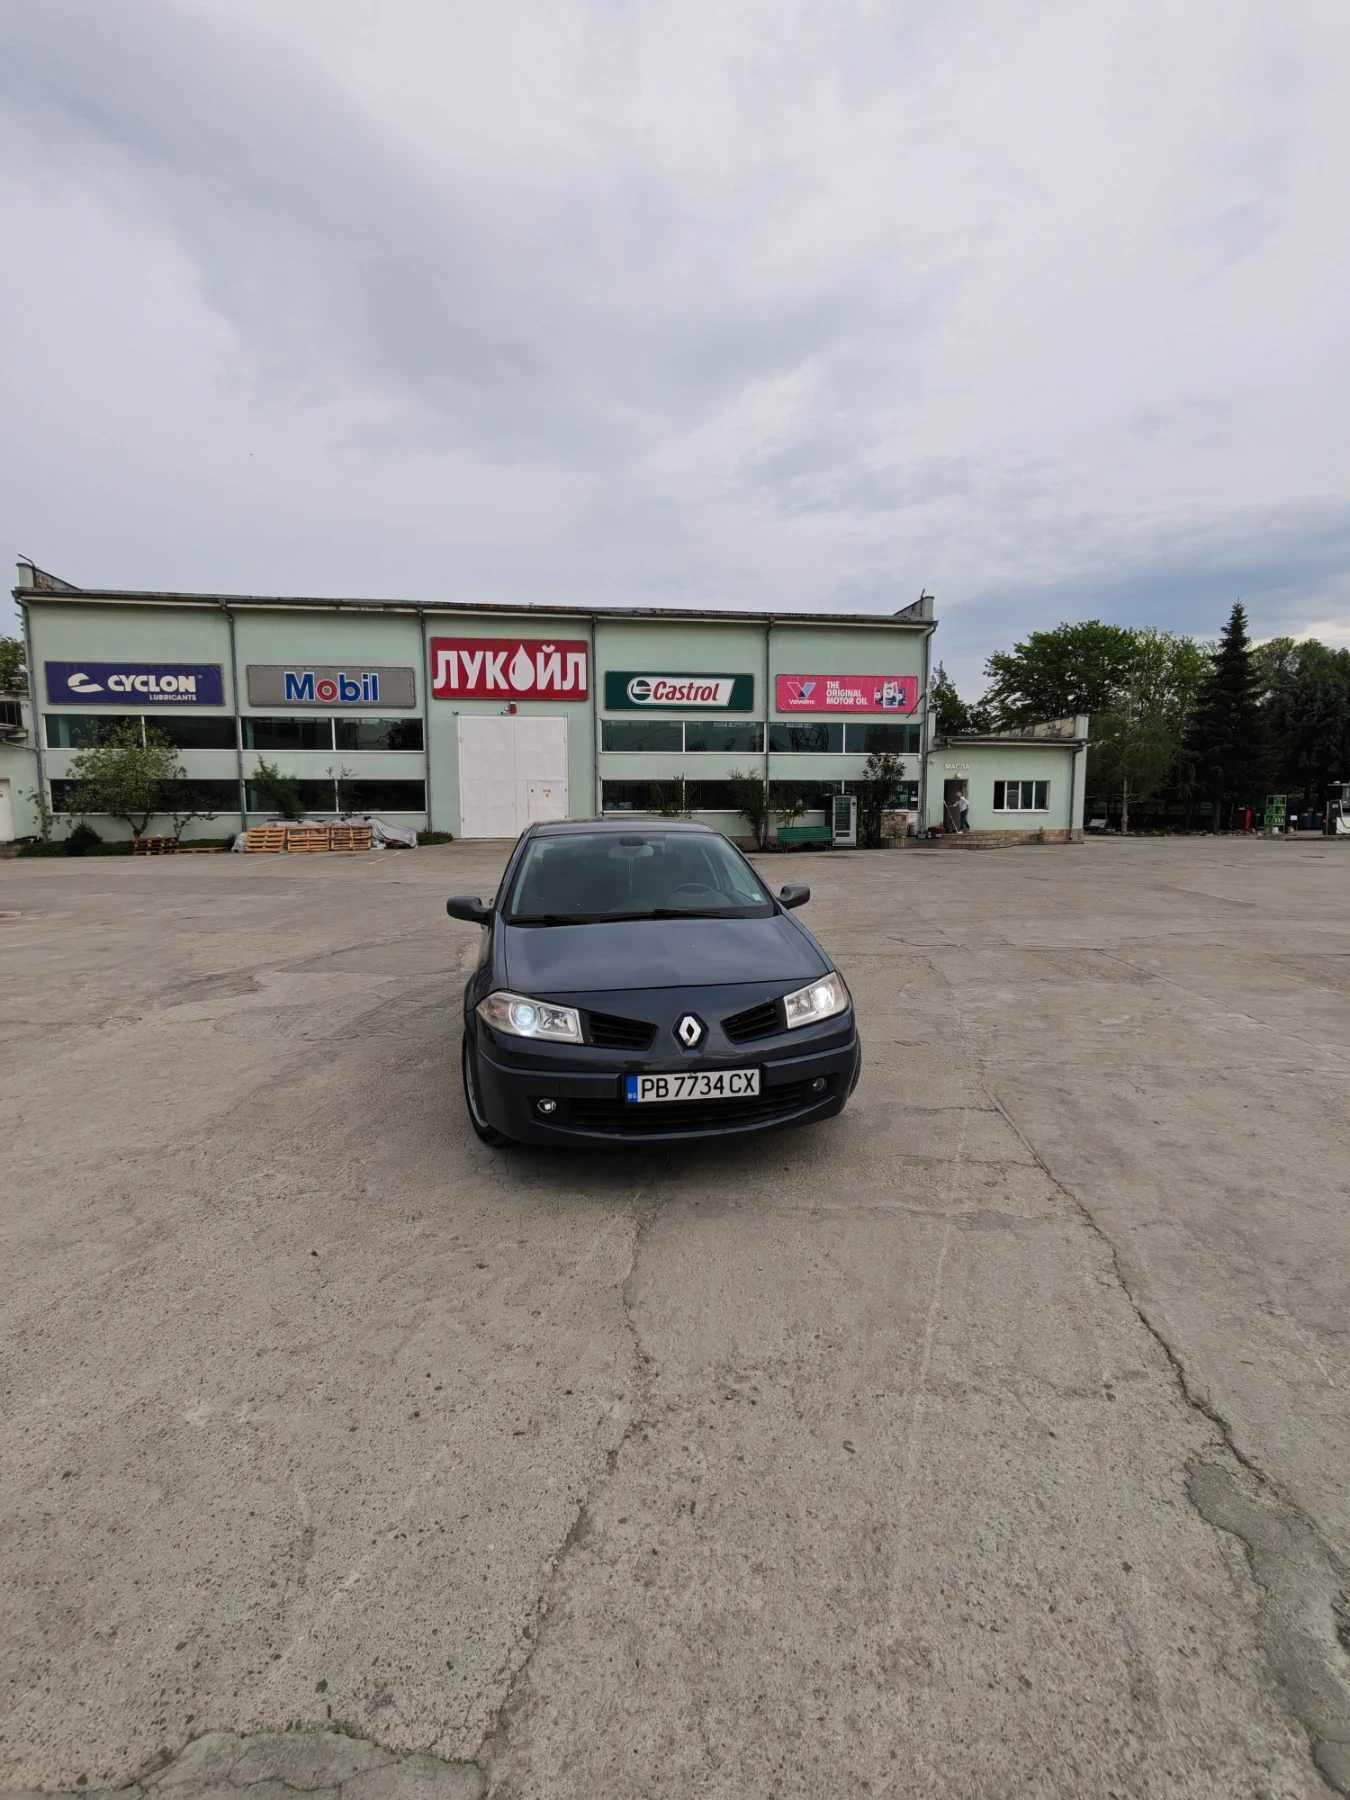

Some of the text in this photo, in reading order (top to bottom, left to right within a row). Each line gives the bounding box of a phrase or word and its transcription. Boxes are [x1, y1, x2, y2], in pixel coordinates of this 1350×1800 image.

[433, 643, 587, 692] ЛУКОЙЛ
[107, 674, 197, 693] CYCLON
[284, 671, 380, 702] Mobil
[653, 681, 720, 701] Castrol
[826, 681, 840, 689] THE
[826, 689, 862, 697] ORIGINAL
[826, 697, 854, 705] MOTOR
[641, 1073, 755, 1099] PB 7734 CX
